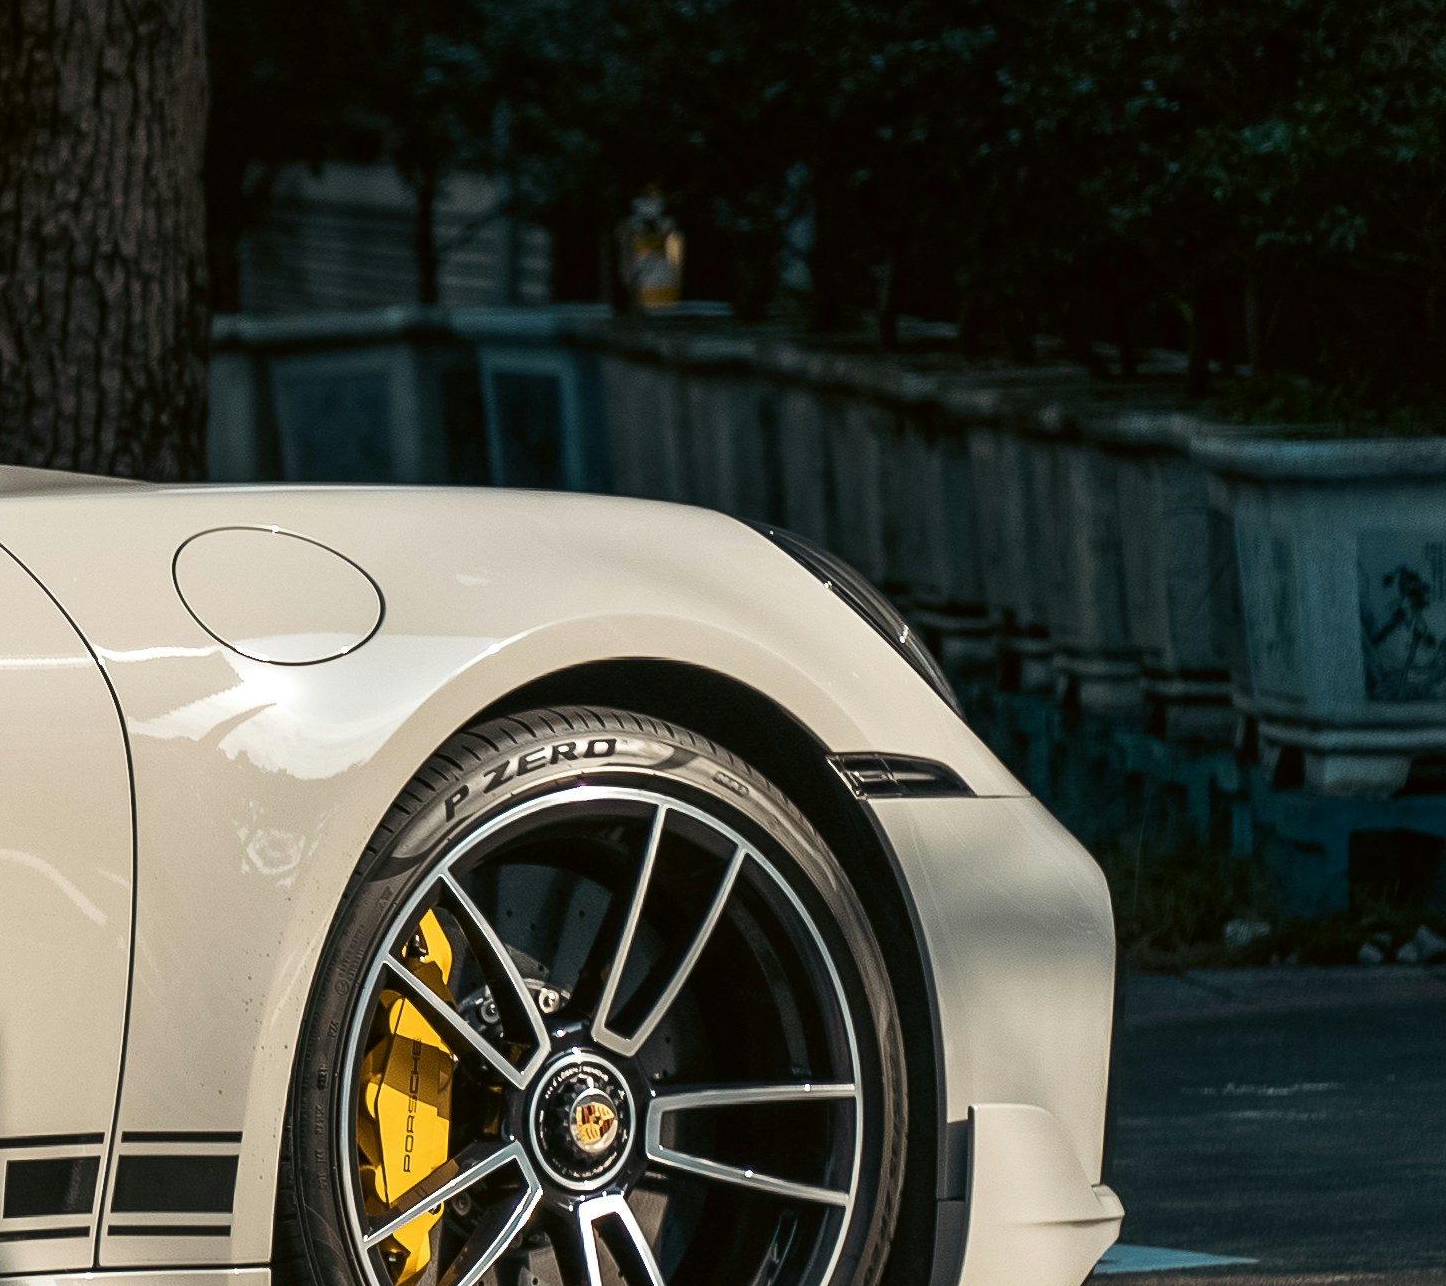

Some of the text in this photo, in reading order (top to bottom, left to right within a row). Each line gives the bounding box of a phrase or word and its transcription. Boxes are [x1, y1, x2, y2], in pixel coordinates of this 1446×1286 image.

[444, 739, 618, 821] P ZERO
[402, 1037, 423, 1175] PORSCHE
